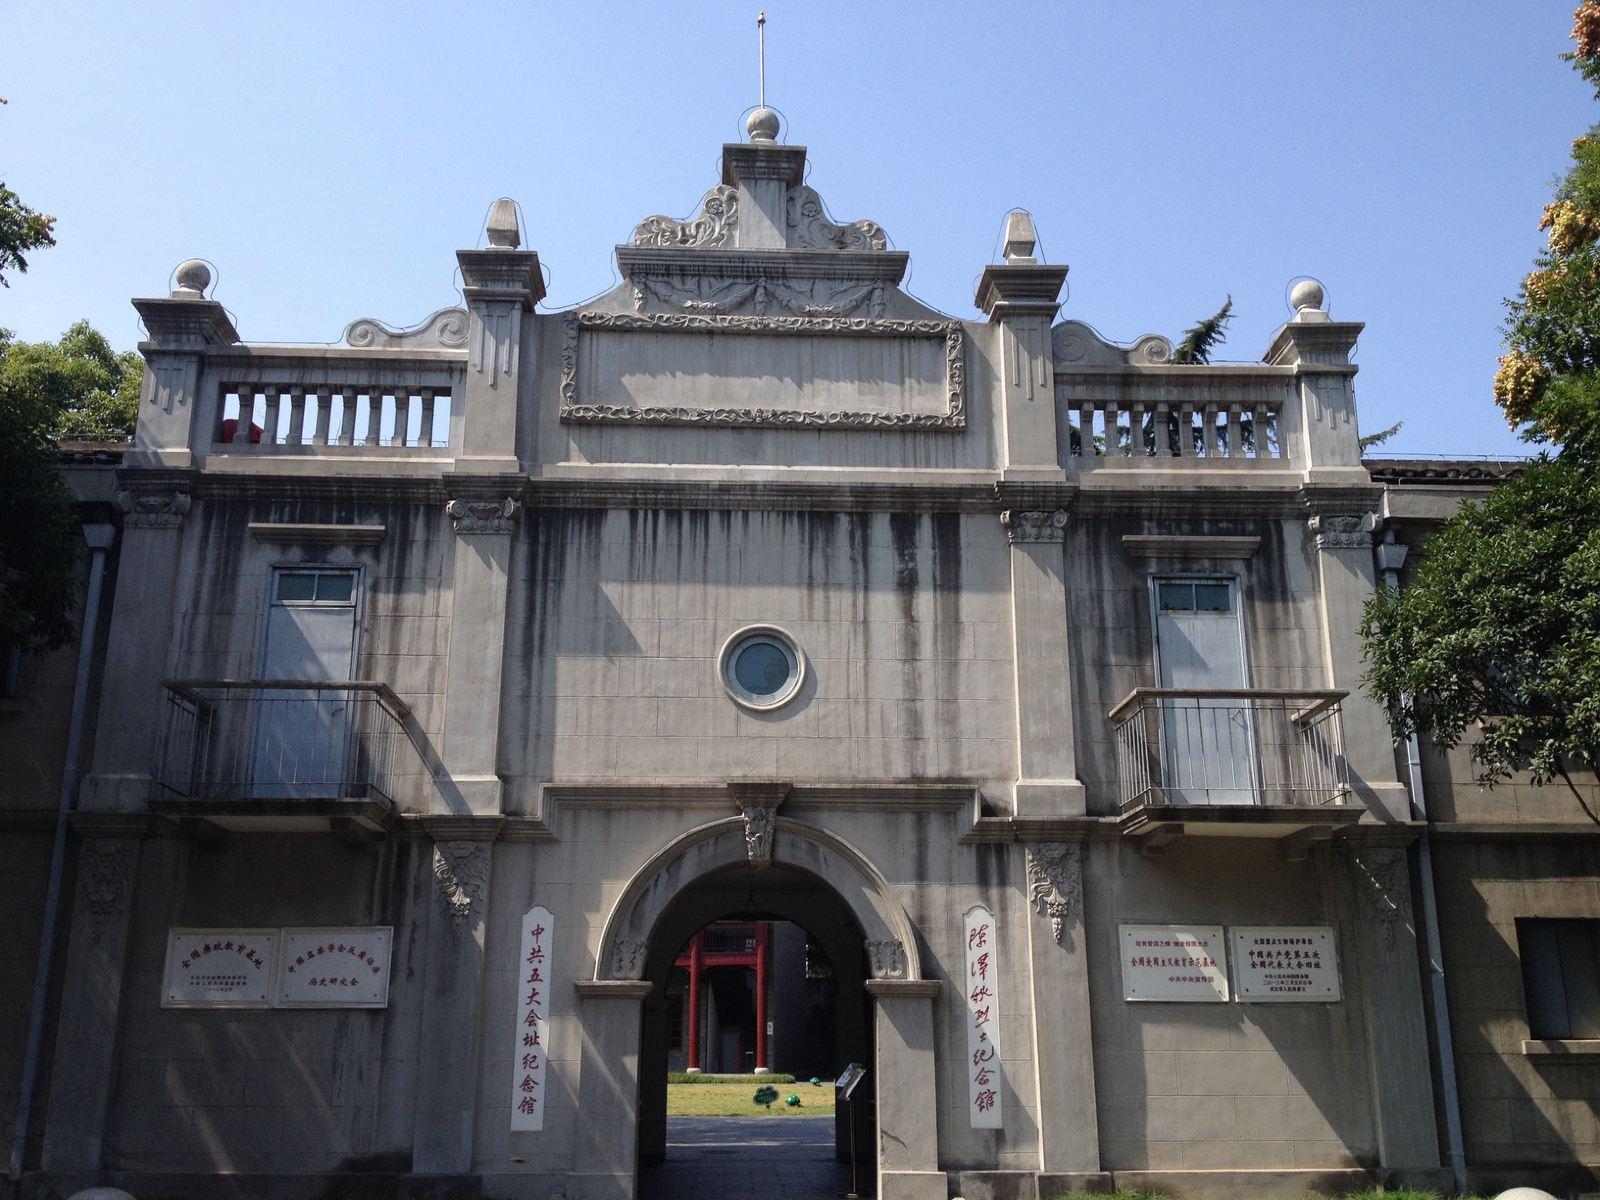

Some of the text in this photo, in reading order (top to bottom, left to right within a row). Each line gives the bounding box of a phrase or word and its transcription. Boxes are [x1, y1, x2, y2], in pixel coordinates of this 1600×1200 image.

[518, 924, 546, 1115] 中共五大会址纪念馆
